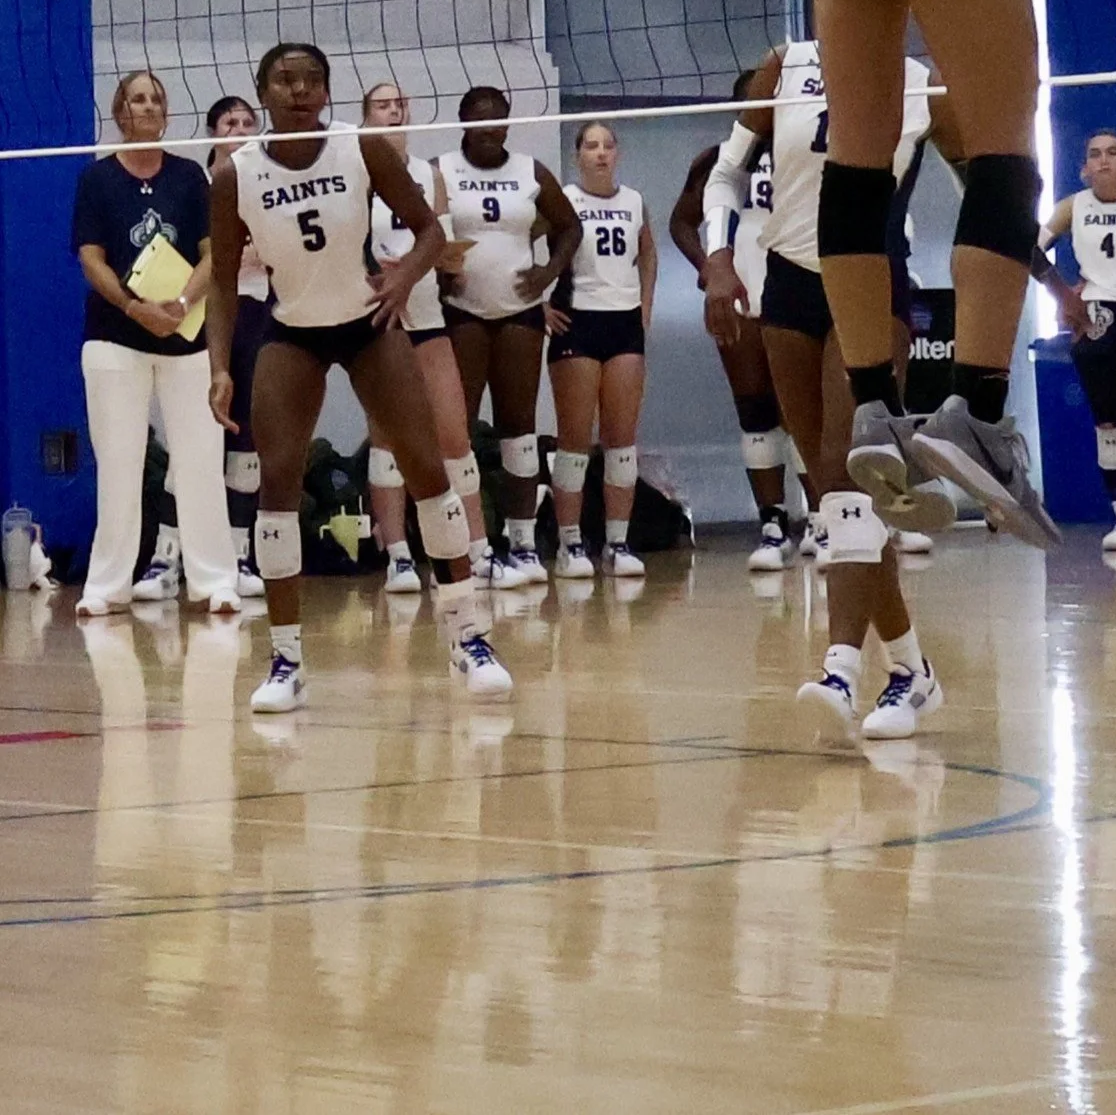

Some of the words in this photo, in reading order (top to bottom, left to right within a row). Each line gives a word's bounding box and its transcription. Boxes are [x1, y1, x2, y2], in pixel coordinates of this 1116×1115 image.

[262, 175, 347, 210] SAINTS
[459, 180, 519, 192] SAINTS
[482, 197, 501, 223] 9
[579, 210, 632, 223] SAINTS
[297, 209, 327, 252] 5
[595, 226, 627, 256] 26
[1100, 231, 1115, 259] 4
